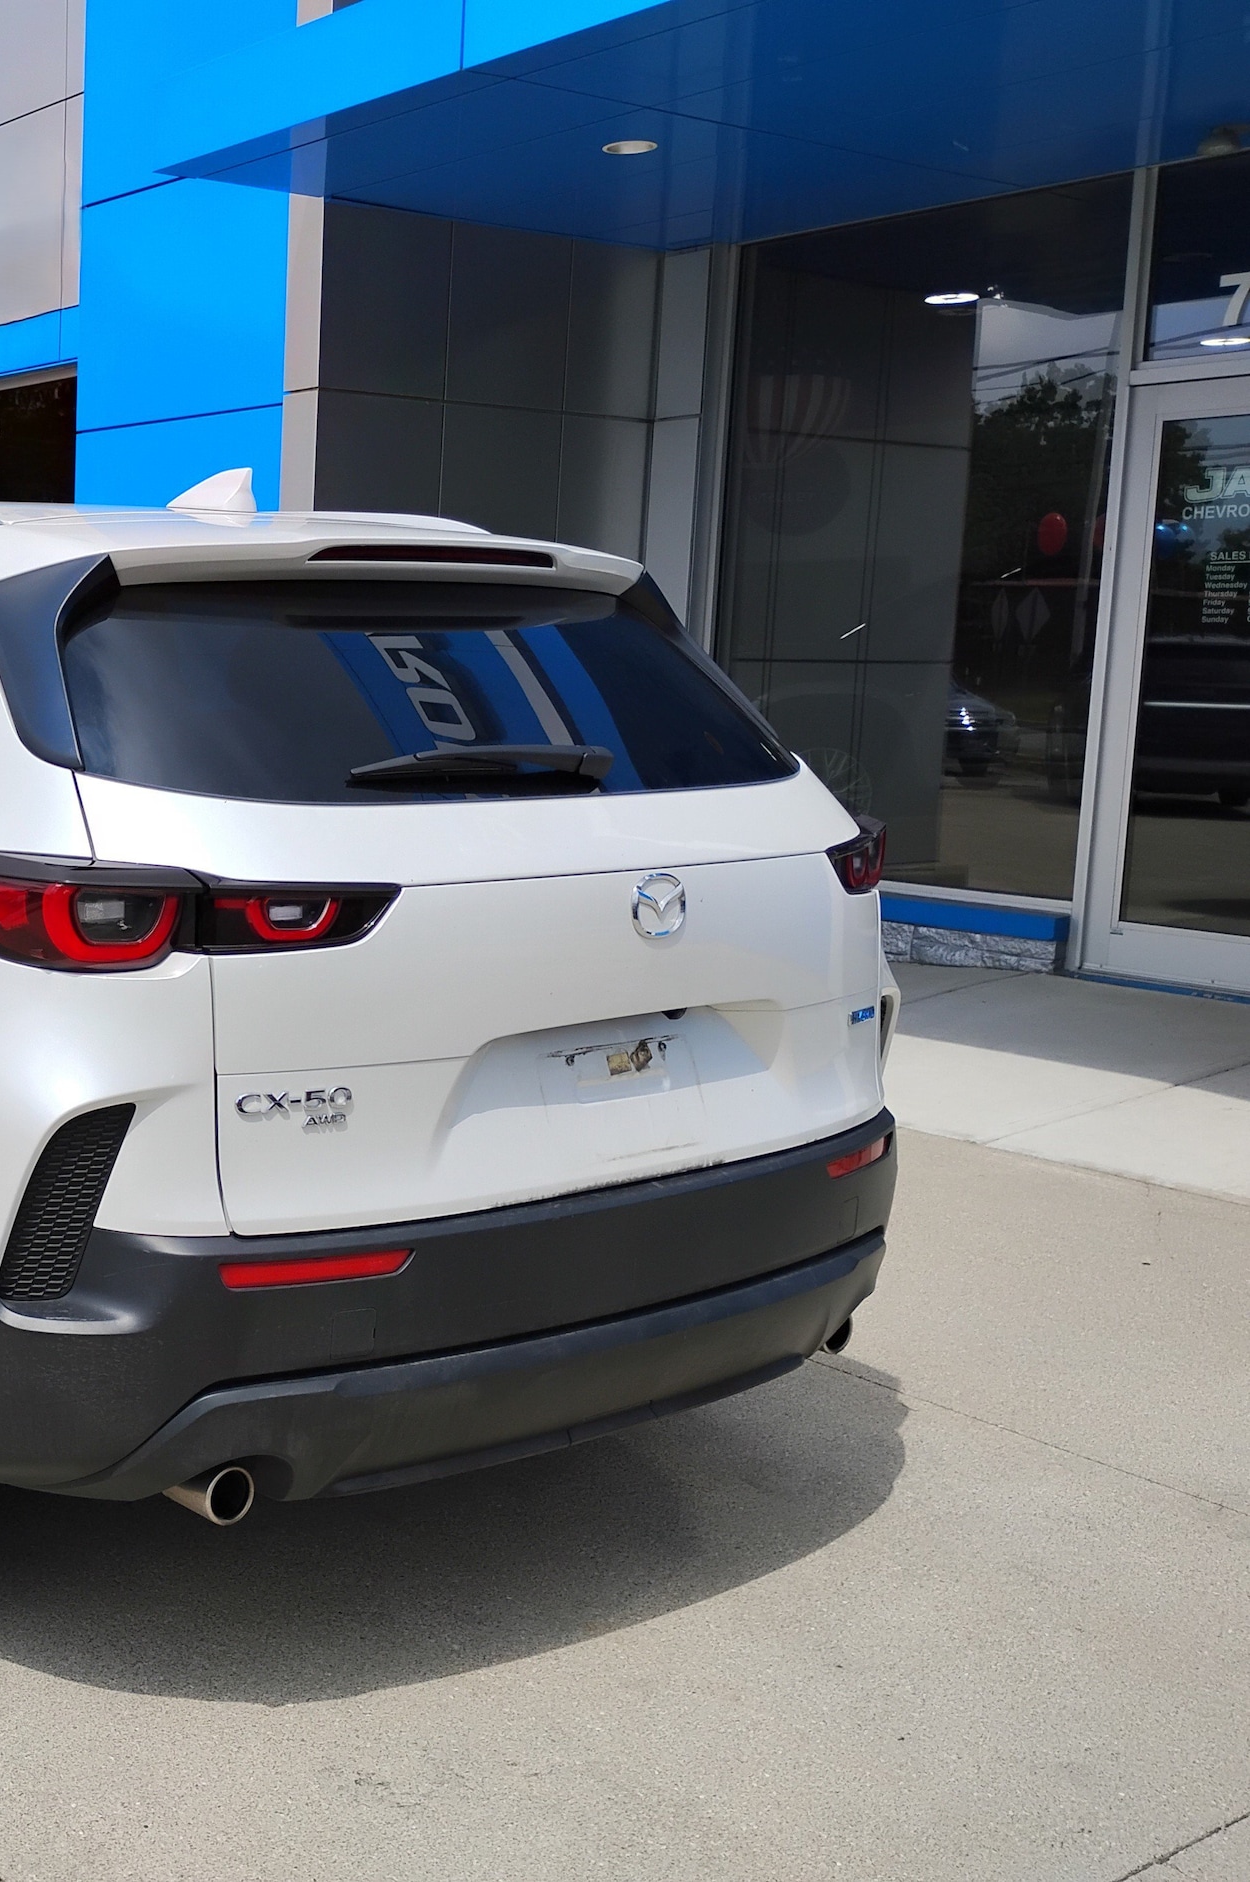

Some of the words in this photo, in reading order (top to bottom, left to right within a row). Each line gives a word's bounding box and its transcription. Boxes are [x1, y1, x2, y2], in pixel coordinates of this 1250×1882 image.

[1219, 271, 1250, 327] 7
[1182, 503, 1250, 520] CHEVRO
[1210, 550, 1247, 561] SALES
[1205, 564, 1236, 573] Monday
[1205, 573, 1236, 582] Tuesday
[1204, 581, 1248, 590] Wednesday
[1203, 590, 1238, 599] Thursday
[1202, 599, 1226, 607] Friday
[1202, 607, 1235, 616] Saturday
[1201, 615, 1230, 625] Sunday
[235, 1086, 353, 1115] CX-50
[301, 1112, 347, 1129] AWD
